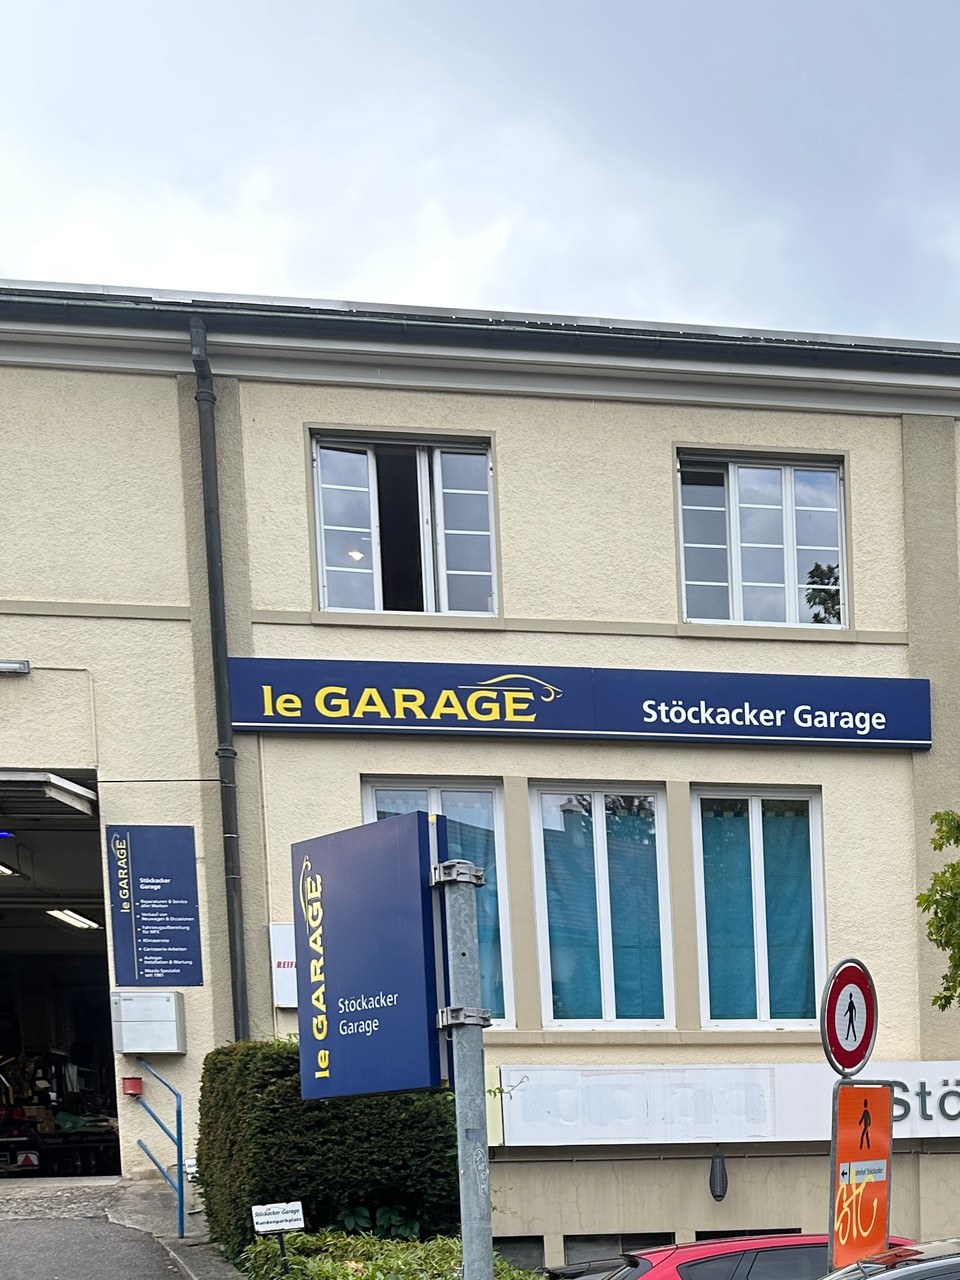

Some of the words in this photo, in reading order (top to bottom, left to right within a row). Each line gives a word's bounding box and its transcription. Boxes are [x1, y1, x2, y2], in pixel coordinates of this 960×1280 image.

[263, 685, 302, 717] le
[315, 687, 537, 722] GARAGE
[642, 699, 786, 730] Stöckacker
[792, 704, 888, 736] Garage
[116, 839, 129, 899] GARAGE
[120, 901, 131, 913] le
[276, 960, 297, 969] REIF
[307, 873, 328, 1041] GARAGE
[338, 991, 400, 1014] Stöckacker
[338, 1018, 380, 1037] Garage
[314, 1048, 330, 1079] le
